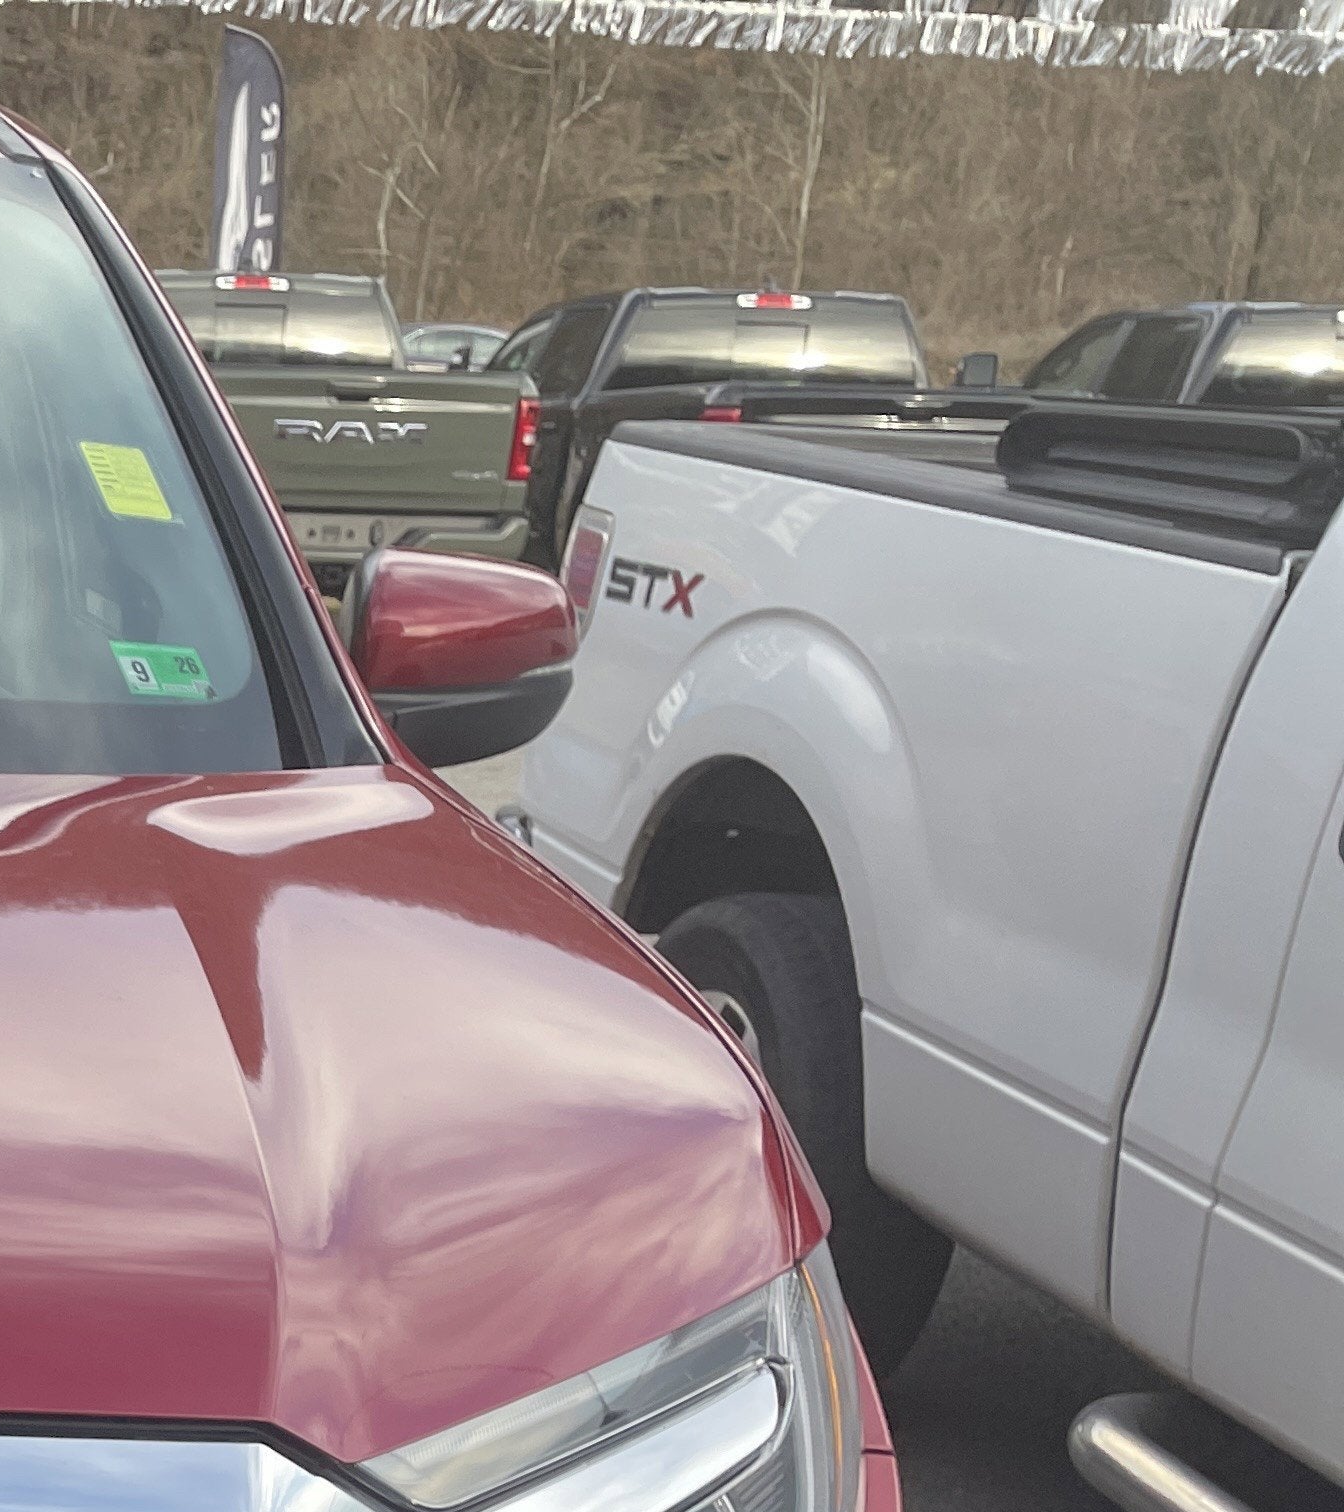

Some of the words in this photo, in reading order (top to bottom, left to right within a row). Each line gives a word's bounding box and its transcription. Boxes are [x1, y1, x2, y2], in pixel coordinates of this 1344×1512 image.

[605, 557, 705, 619] STX
[131, 660, 150, 682] 9
[173, 656, 200, 674] 26
